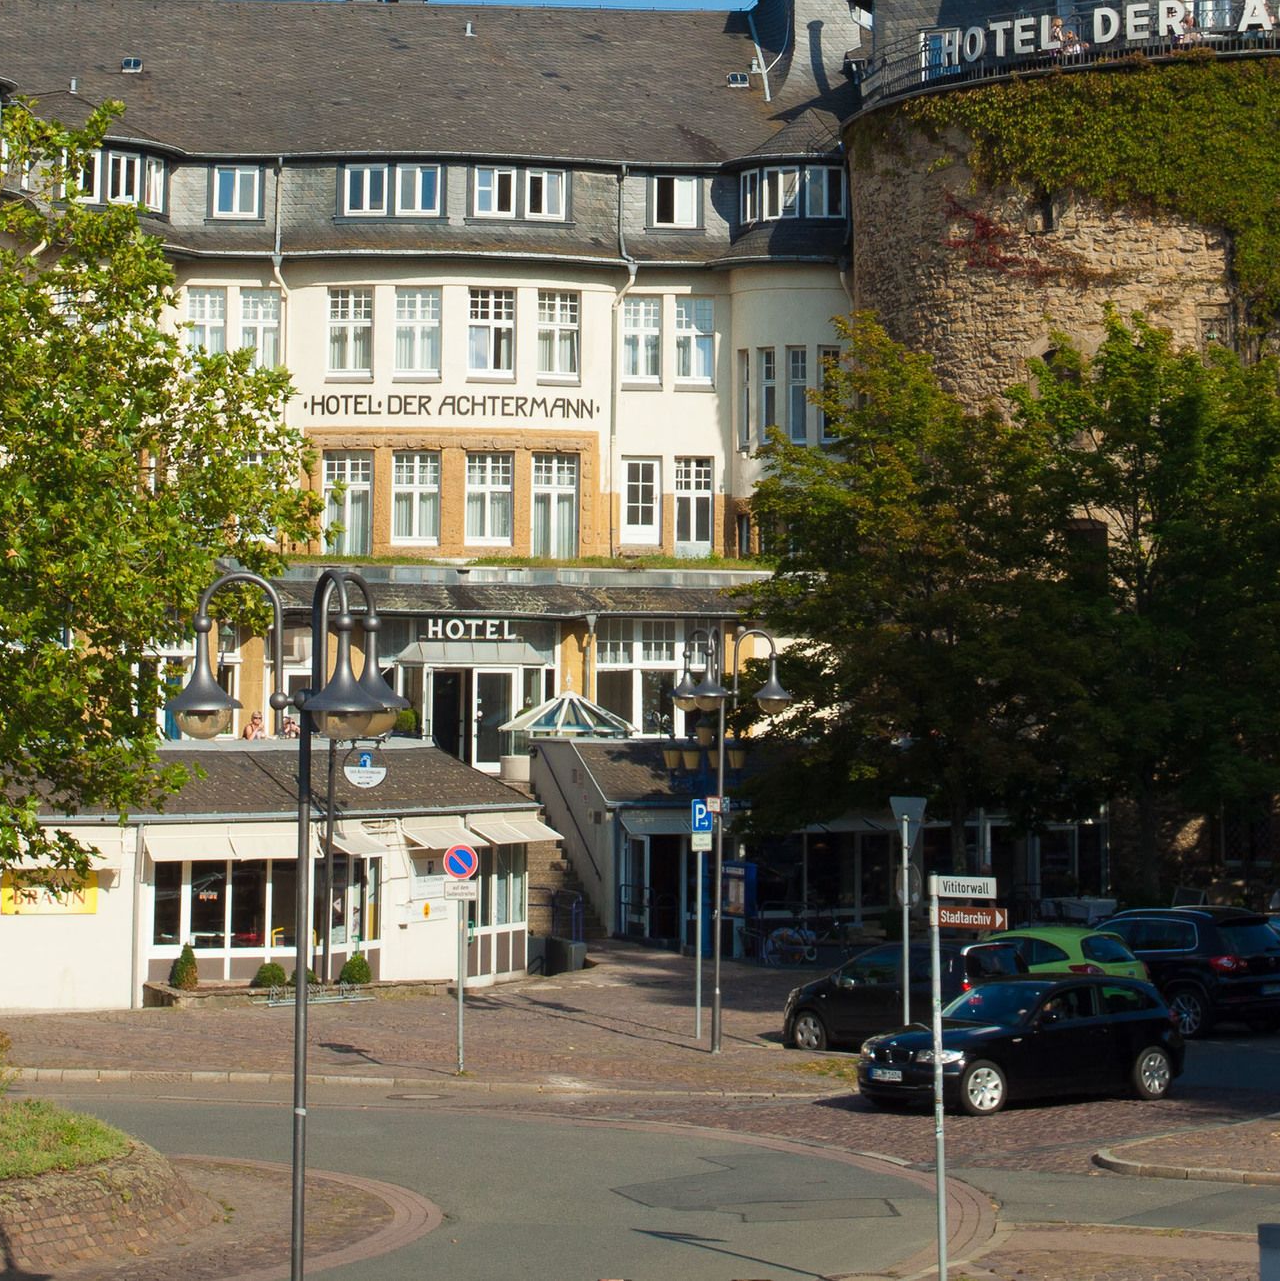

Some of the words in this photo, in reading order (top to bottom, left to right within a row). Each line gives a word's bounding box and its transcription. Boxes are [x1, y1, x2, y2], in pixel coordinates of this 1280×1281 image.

[941, 14, 1061, 67] HOTEL
[1093, 0, 1186, 44] DER
[310, 395, 379, 416] HOTEL
[387, 395, 433, 416] DER
[438, 395, 594, 419] ACHTERMANN
[427, 619, 517, 640] HOTEL
[695, 803, 707, 828] P
[942, 880, 989, 895] Vititorwall
[940, 909, 992, 925] Stadtarchiv
